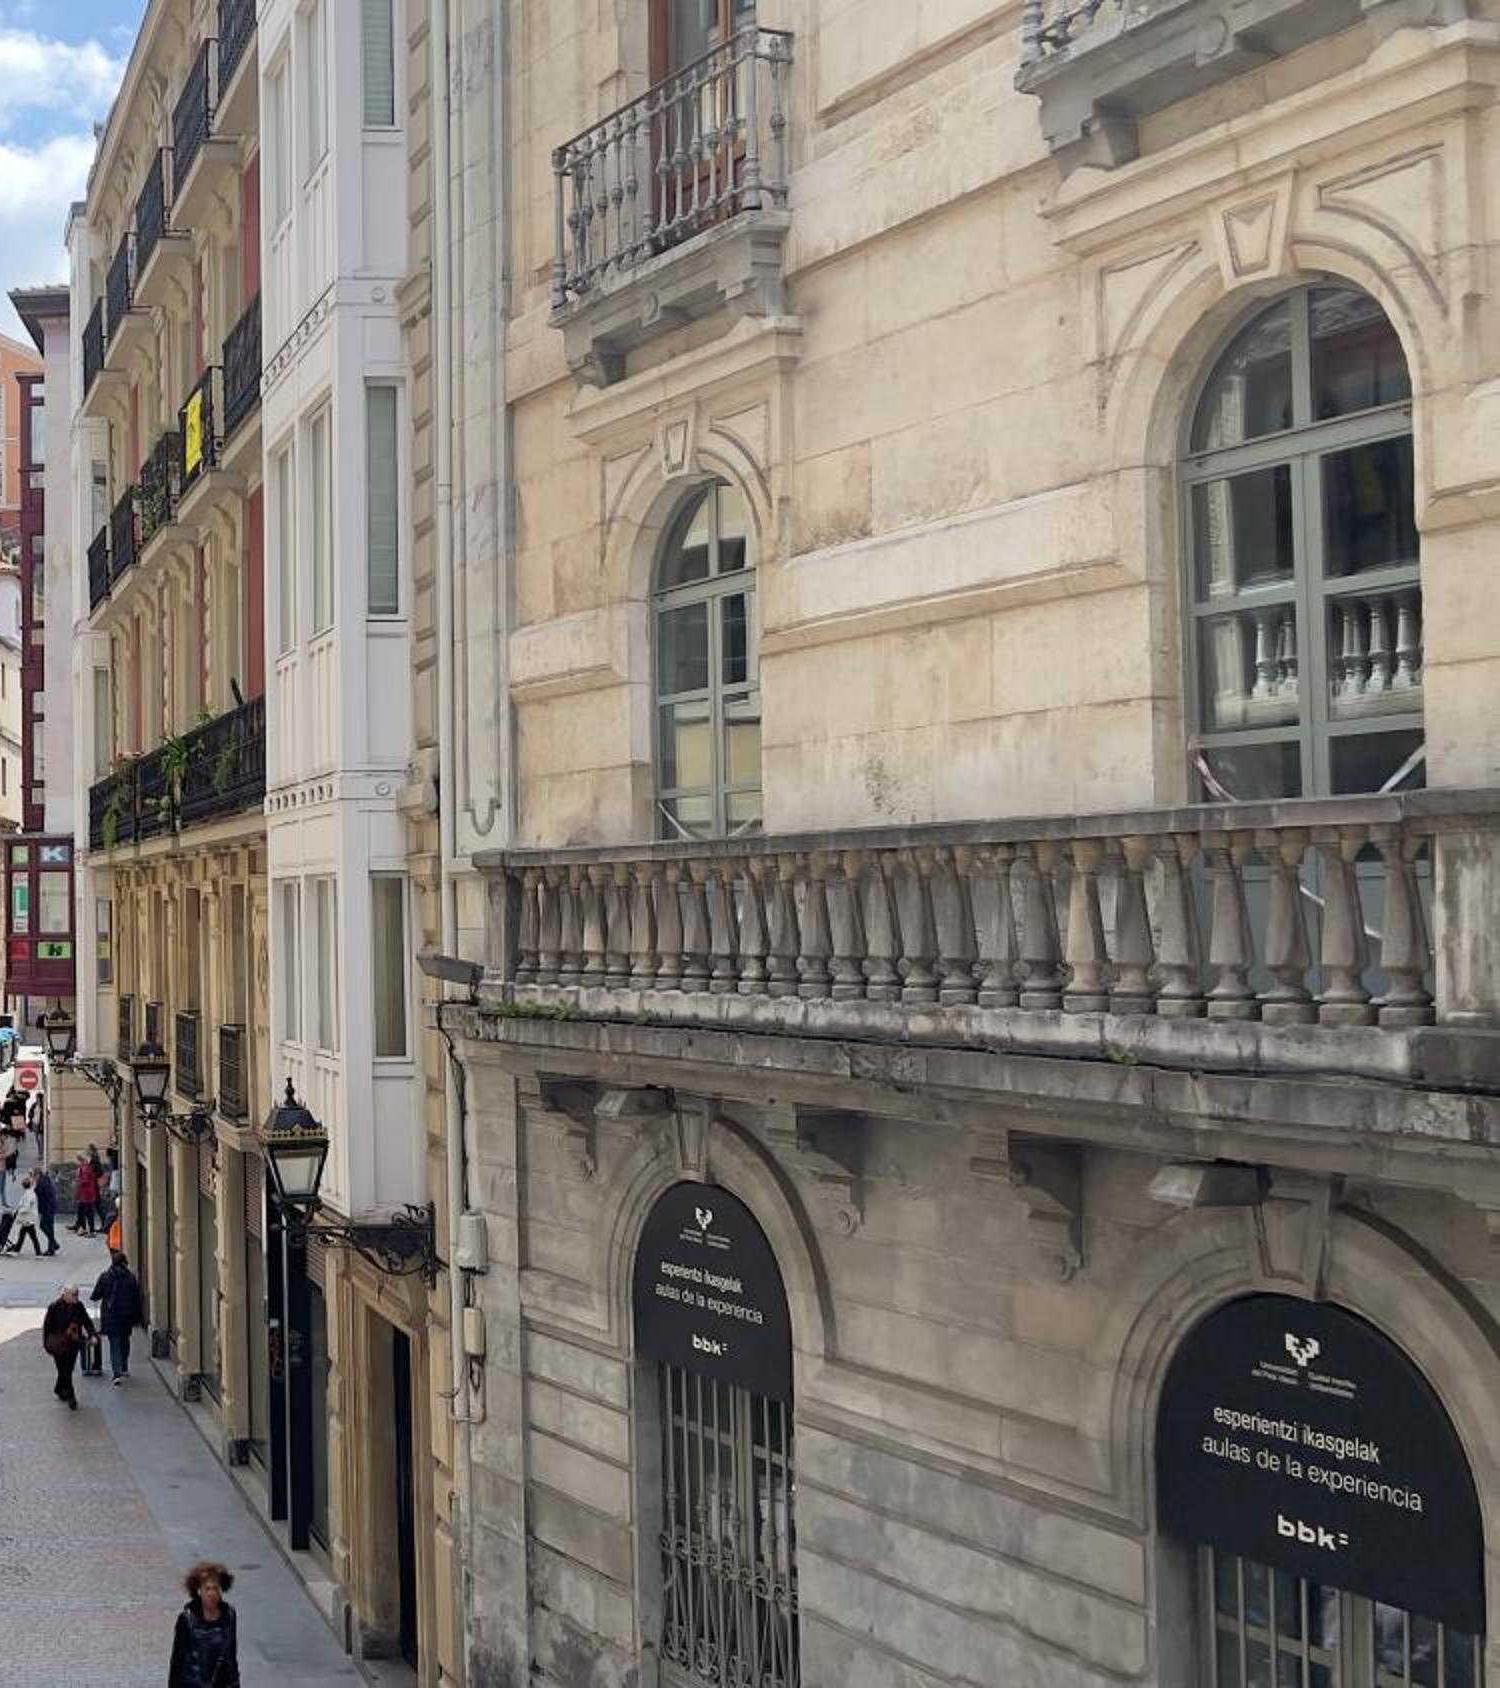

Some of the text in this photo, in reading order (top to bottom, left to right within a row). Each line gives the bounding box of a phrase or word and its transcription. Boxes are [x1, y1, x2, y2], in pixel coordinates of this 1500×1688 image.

[682, 1288, 695, 1304] de
[1213, 1407, 1380, 1465] esperientzi ikasgelak
[1203, 1436, 1423, 1512] aulas de la experiencia
